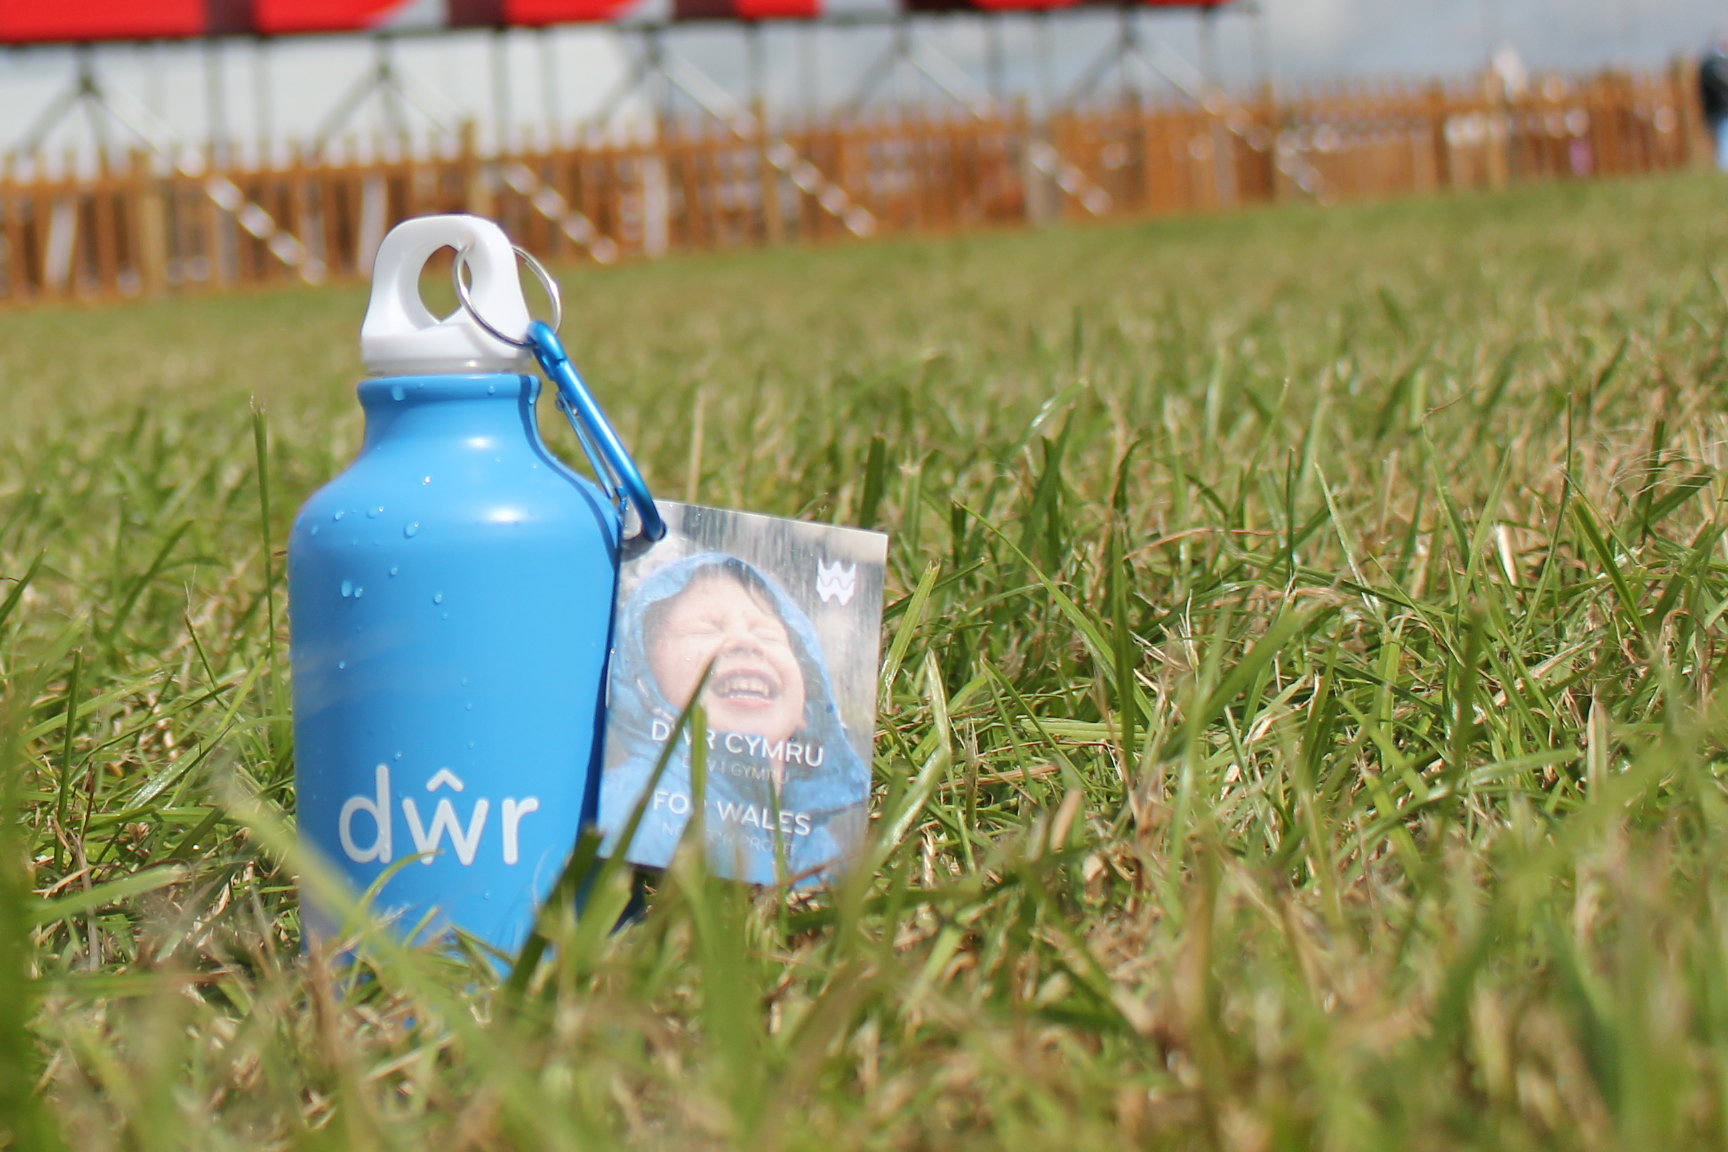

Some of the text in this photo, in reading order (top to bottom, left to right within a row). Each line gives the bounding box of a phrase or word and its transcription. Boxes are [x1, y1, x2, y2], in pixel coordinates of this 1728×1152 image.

[725, 733, 824, 767] CYMRU
[339, 764, 540, 866] dŵr
[653, 792, 812, 836] FO WALES
